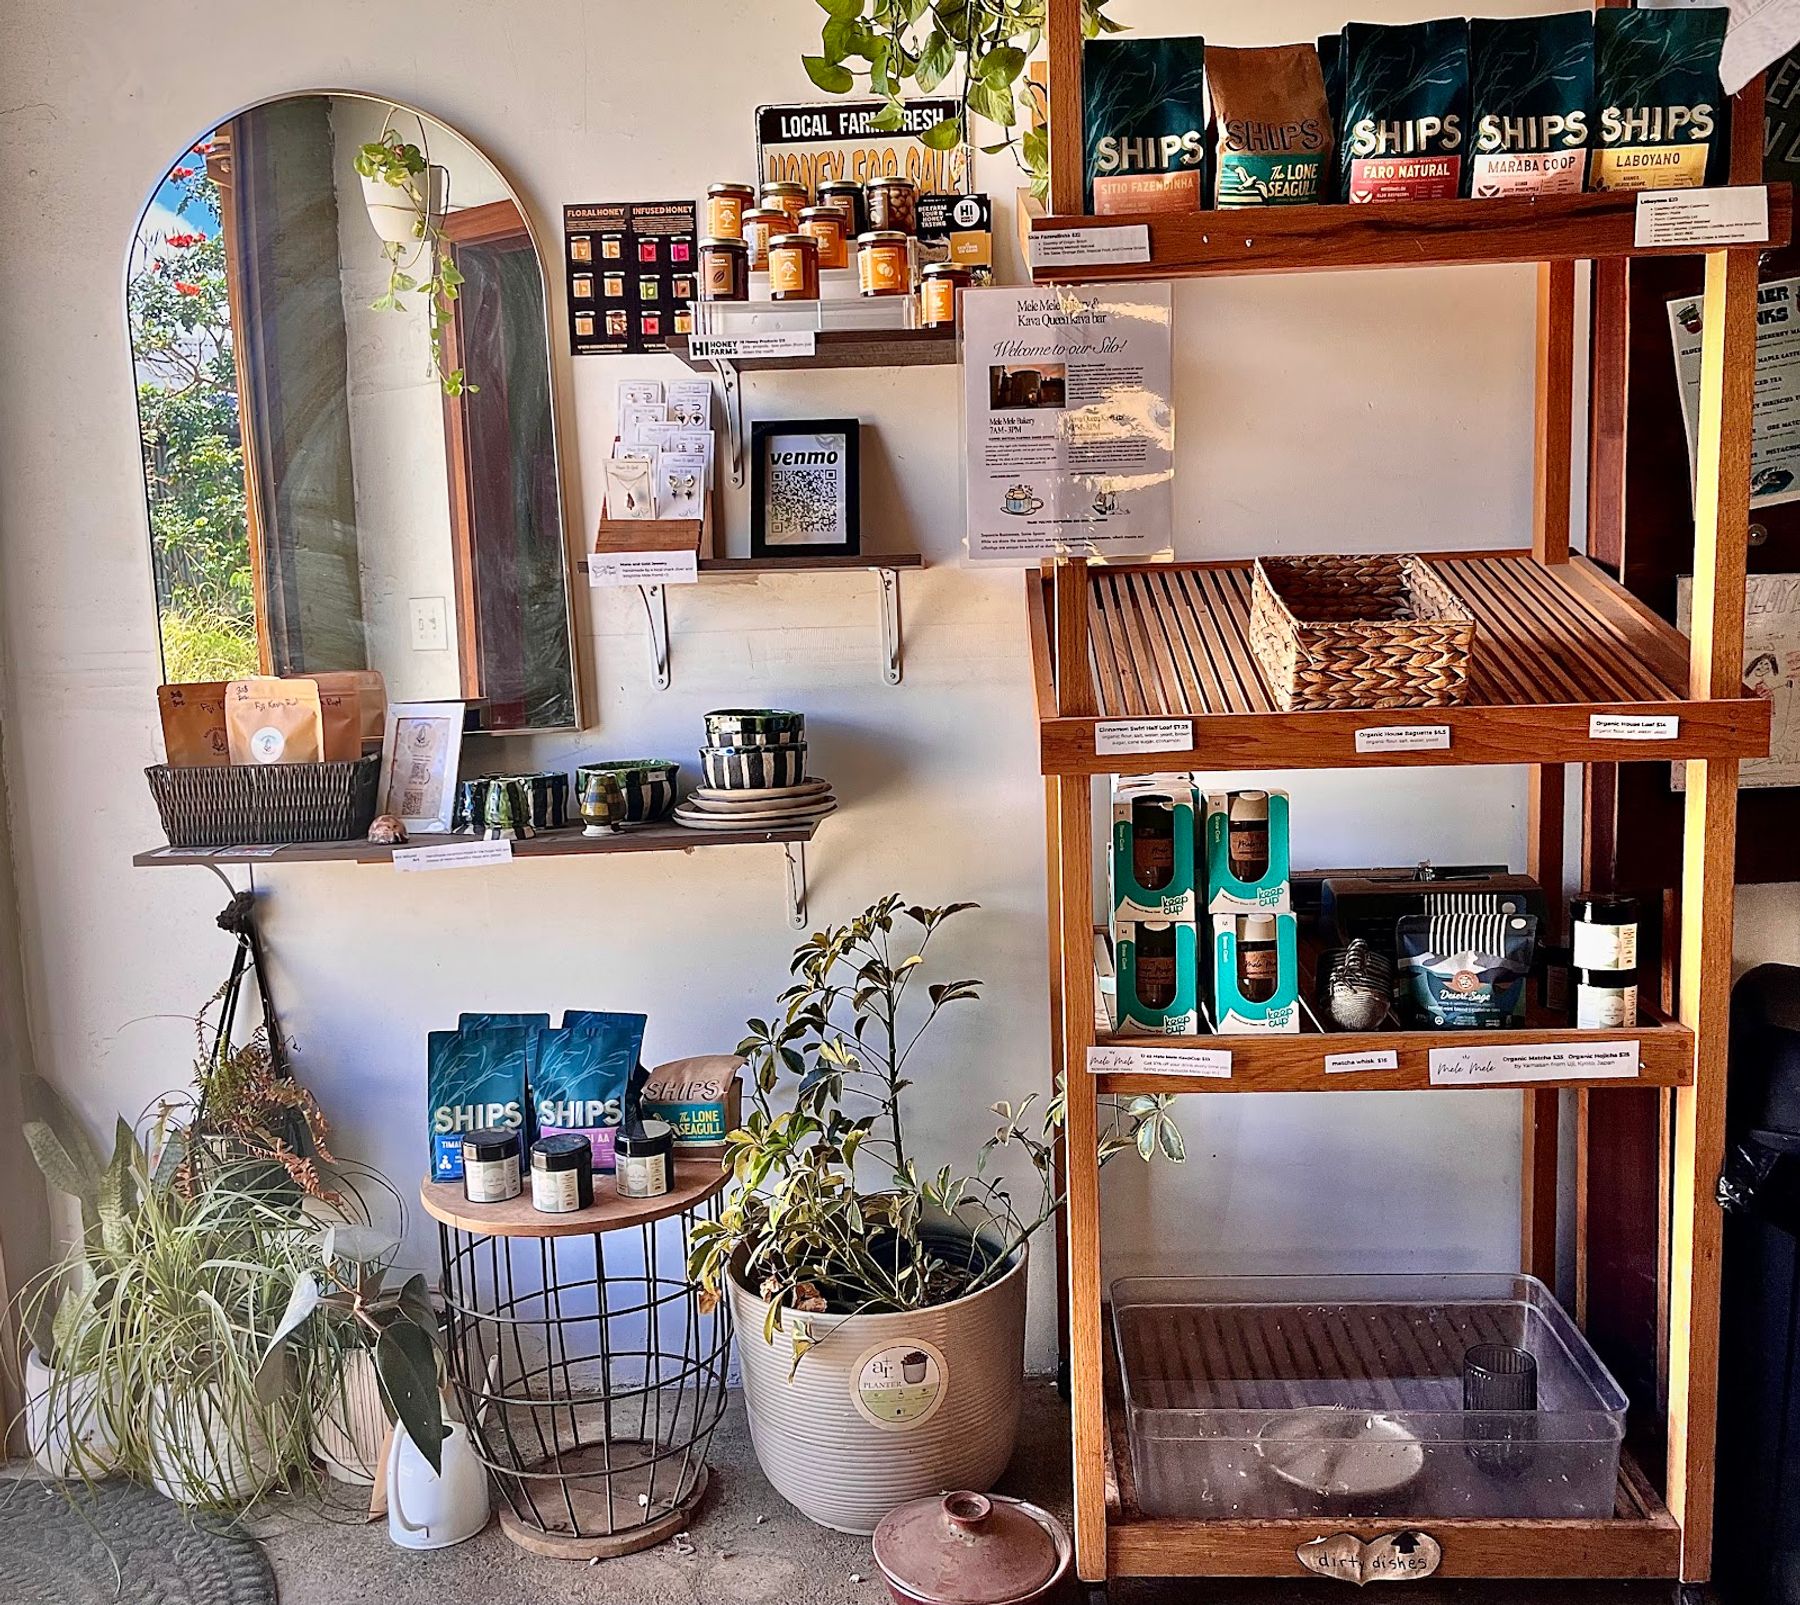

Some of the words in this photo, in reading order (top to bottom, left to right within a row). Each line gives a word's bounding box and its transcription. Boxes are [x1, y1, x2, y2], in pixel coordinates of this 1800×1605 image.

[781, 114, 832, 138] LOCAL
[1601, 104, 1714, 142] SHIPS
[1226, 120, 1323, 151] SHIPS
[1351, 114, 1461, 156] SHIPS
[1477, 111, 1588, 150] SHIPS
[1095, 131, 1204, 171] SHIPS
[853, 146, 898, 188] FOR
[1488, 160, 1539, 173] MARABA
[1543, 156, 1576, 171] COOP
[1616, 153, 1680, 167] LABOYANO
[1271, 165, 1285, 180] The
[1287, 164, 1318, 180] LONE
[1363, 165, 1394, 179] FARO
[1398, 164, 1450, 178] NATURAL
[1101, 183, 1127, 195] SITIO
[1132, 178, 1194, 192] FAZENDINHA
[1268, 181, 1317, 197] SEAGULL
[567, 208, 600, 217] FLORAL
[600, 207, 625, 216] HONEY
[632, 207, 665, 215] INFUSED
[666, 205, 693, 213] HONEY
[960, 205, 973, 216] HI
[1017, 300, 1038, 312] Mele
[1040, 299, 1060, 312] Mele
[1018, 315, 1040, 327] Kava
[1041, 313, 1069, 328] Queen
[1070, 312, 1090, 325] kava
[1092, 312, 1107, 324] bar
[692, 342, 709, 356] HI
[711, 347, 738, 355] FARMS
[993, 340, 1051, 357] Welcome
[1051, 344, 1065, 356] to
[1068, 345, 1091, 355] our
[1093, 336, 1128, 355] Silo!
[770, 450, 838, 466] venmo
[1257, 886, 1284, 899] keep
[1161, 896, 1188, 908] keep
[1259, 896, 1279, 907] cup
[1163, 905, 1183, 915] cup
[1440, 990, 1468, 1000] Desert
[1469, 990, 1490, 1003] Sage
[1164, 1015, 1190, 1026] keep
[1266, 1007, 1293, 1020] keep
[1268, 1018, 1289, 1028] cup
[1166, 1025, 1186, 1036] cup
[1089, 1056, 1110, 1067] Mele
[1113, 1055, 1135, 1067] Mele
[1437, 1061, 1464, 1076] Mele
[1469, 1060, 1496, 1075] Mele
[644, 1079, 720, 1101] SHIPS
[434, 1101, 522, 1132] SHIPS
[540, 1099, 623, 1128] SHIPS
[692, 1110, 720, 1122] LONE
[680, 1122, 723, 1136] SEAGULL
[597, 1133, 610, 1143] AA
[864, 1381, 902, 1389] PLANTER
[1318, 1552, 1365, 1573] dirty
[1372, 1554, 1427, 1570] dishes
